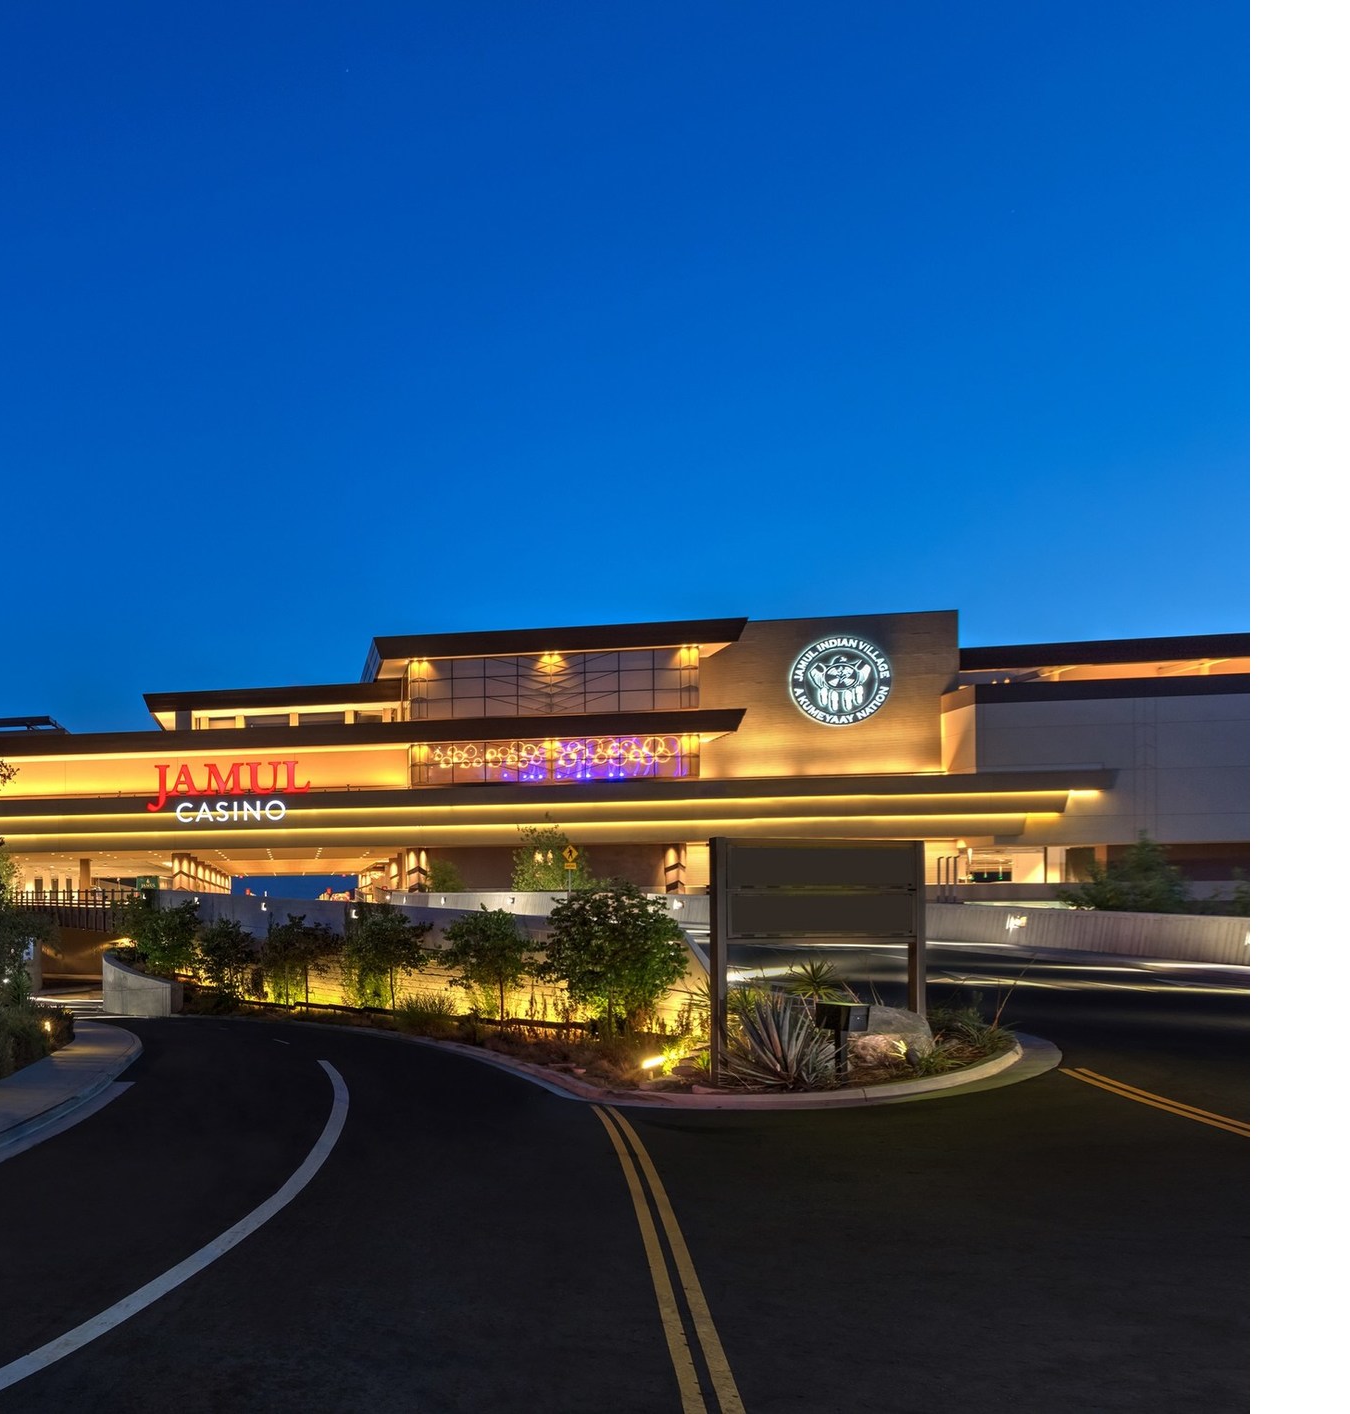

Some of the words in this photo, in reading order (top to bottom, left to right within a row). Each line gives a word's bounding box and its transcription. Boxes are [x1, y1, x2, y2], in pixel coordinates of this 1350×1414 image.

[794, 651, 818, 682] JAMUL
[816, 638, 858, 652] INDIAN
[858, 641, 890, 679] VILLAGE
[793, 687, 804, 697] A
[856, 686, 890, 720] NATION
[797, 695, 855, 724] KUMEYAAY
[146, 760, 311, 812] JAMUL
[175, 800, 286, 823] CASINO
